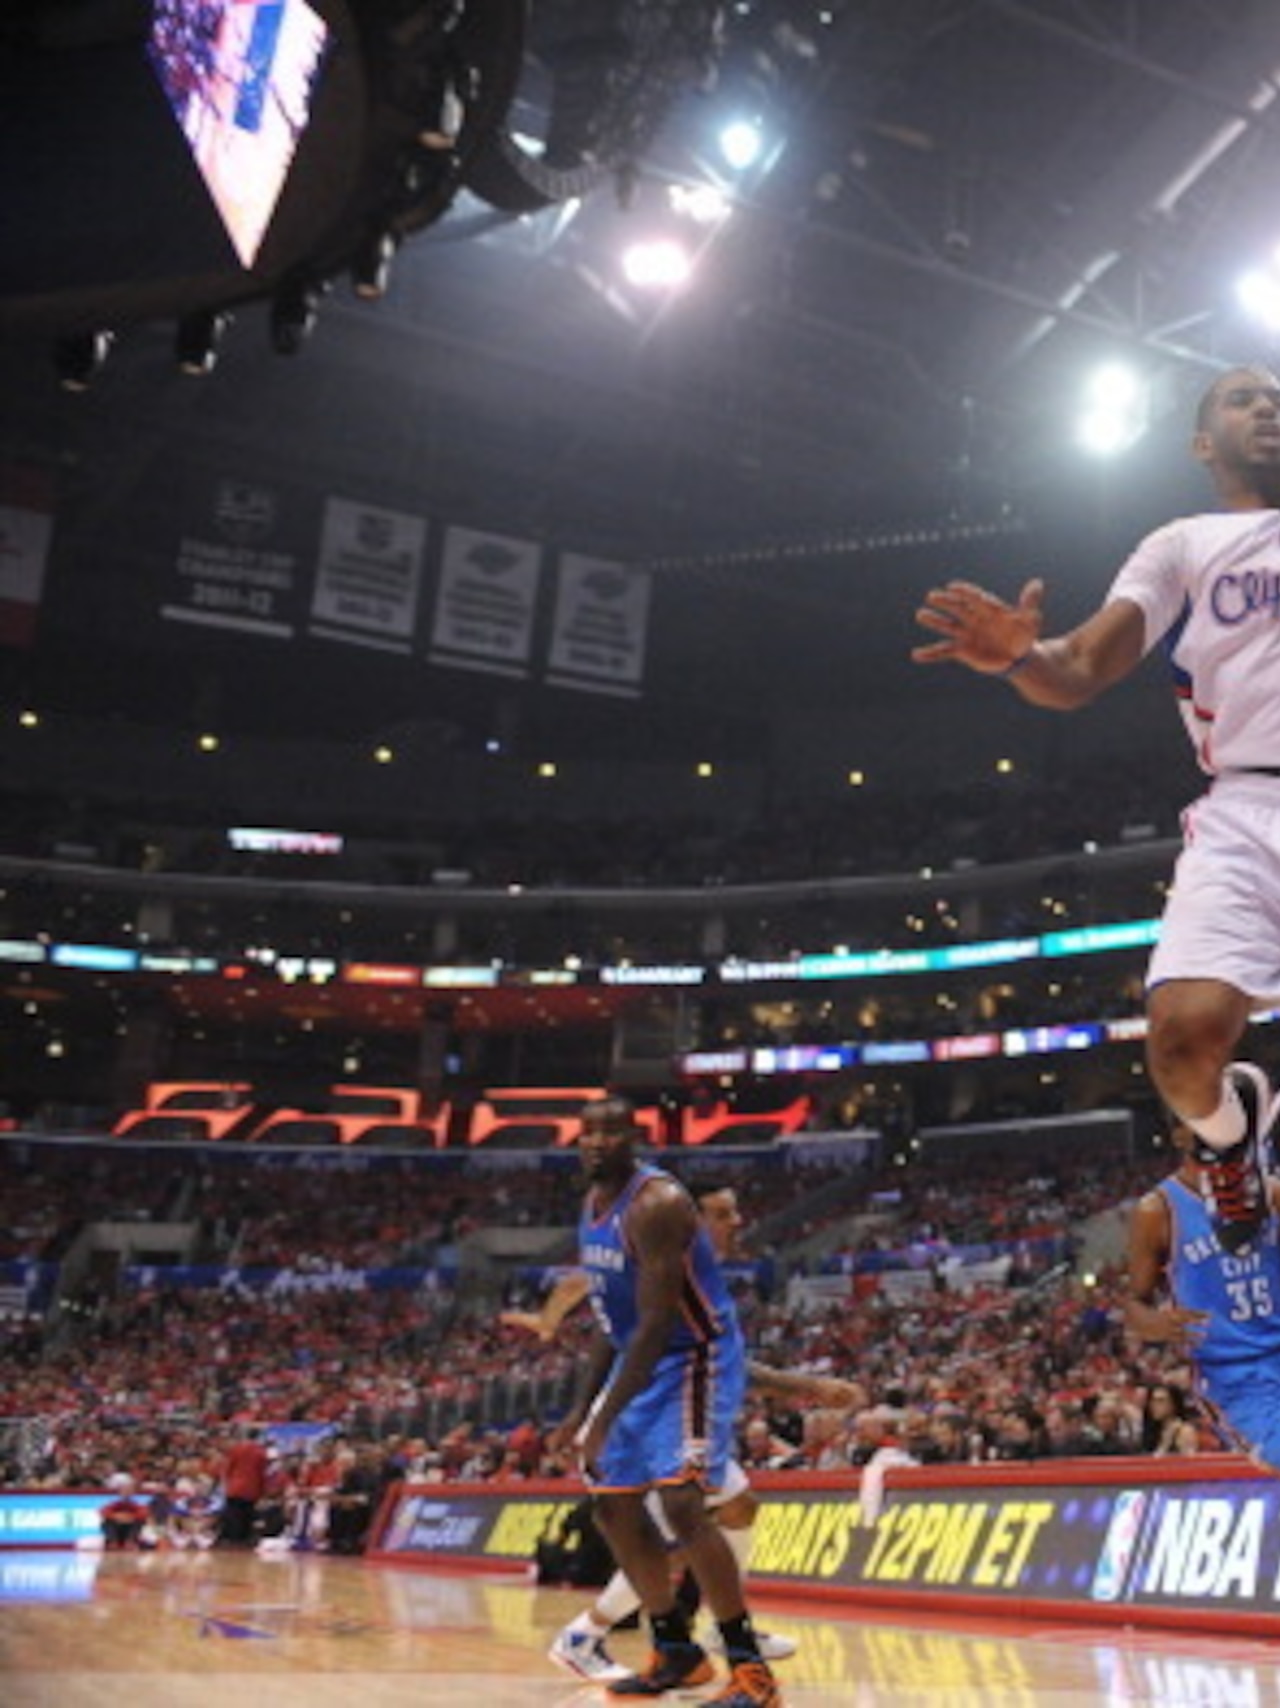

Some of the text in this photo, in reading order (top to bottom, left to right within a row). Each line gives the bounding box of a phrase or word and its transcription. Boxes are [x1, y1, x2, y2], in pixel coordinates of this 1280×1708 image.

[1226, 1278, 1273, 1321] 35
[862, 1504, 988, 1584] 12PM
[972, 1503, 1055, 1587] ET
[1144, 1499, 1264, 1597] NBA
